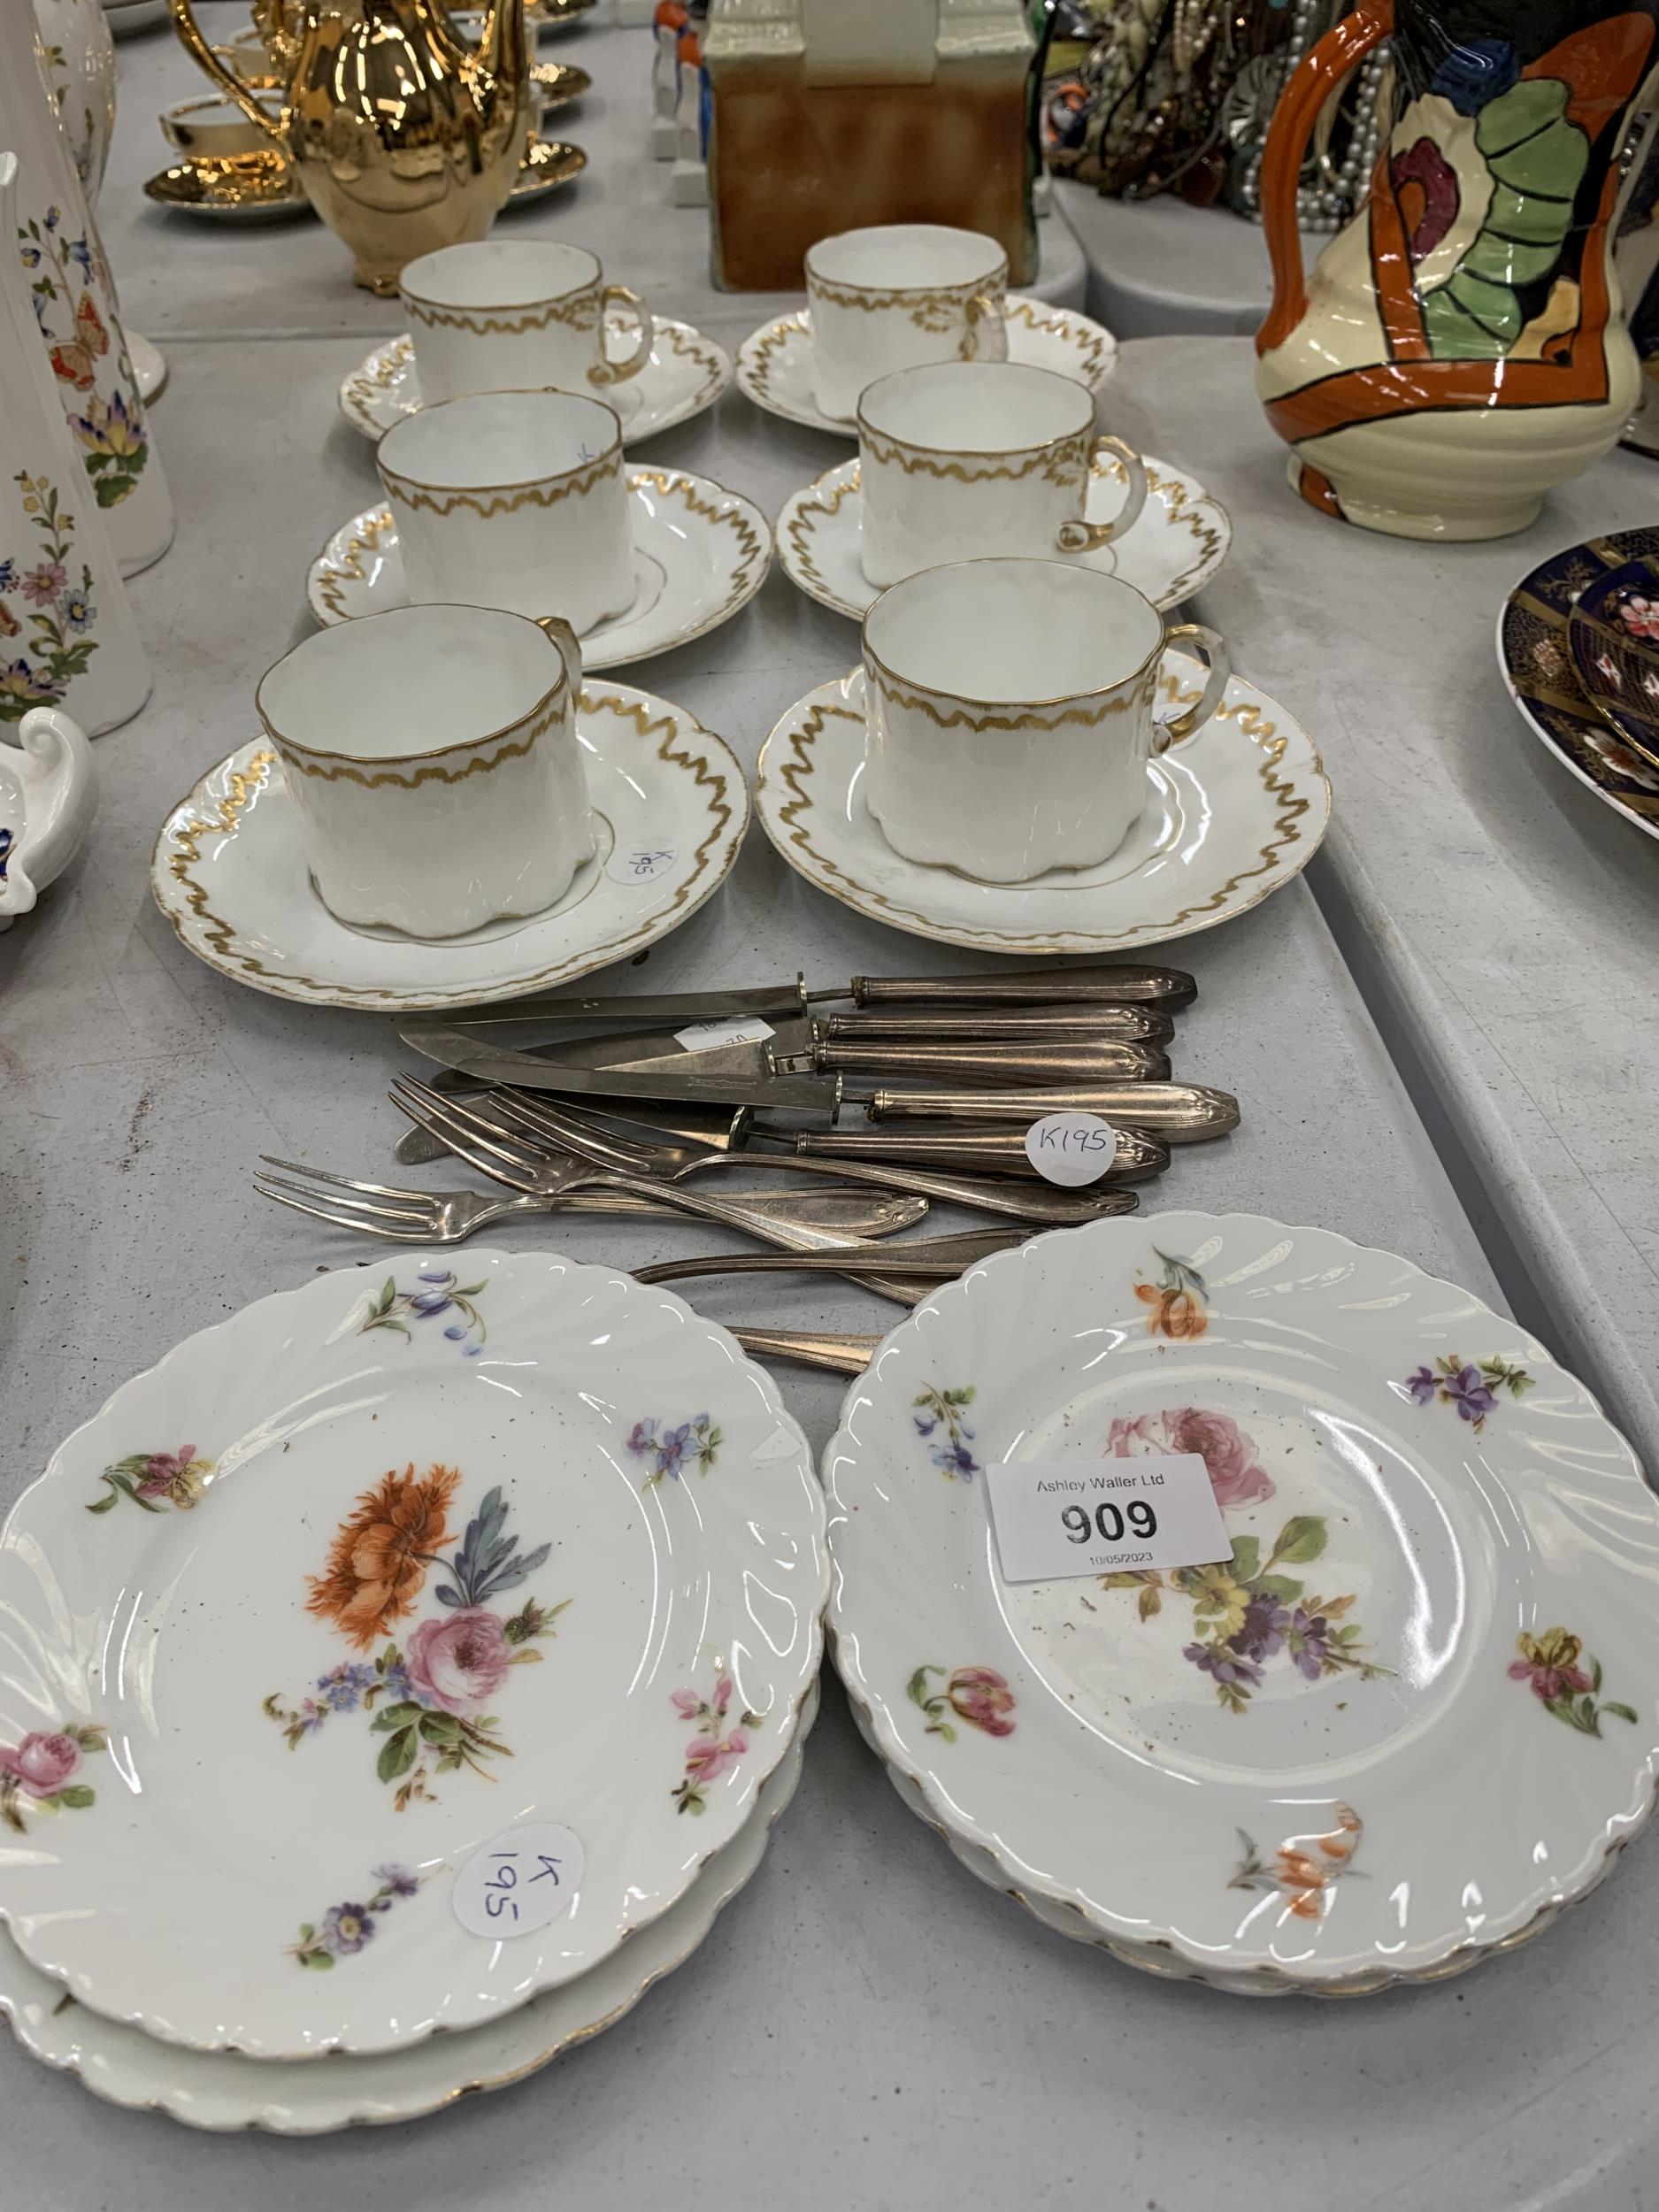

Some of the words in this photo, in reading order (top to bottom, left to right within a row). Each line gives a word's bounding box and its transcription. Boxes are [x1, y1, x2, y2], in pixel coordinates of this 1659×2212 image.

[1040, 1126, 1108, 1152] K195
[1036, 1478, 1086, 1494] Ashley
[1089, 1474, 1138, 1490] Waller
[1141, 1473, 1165, 1486] Ltd
[1061, 1500, 1157, 1544] 909
[1088, 1551, 1154, 1565] 10/05/2023
[527, 1855, 563, 1886] K
[484, 1852, 519, 1922] 195
